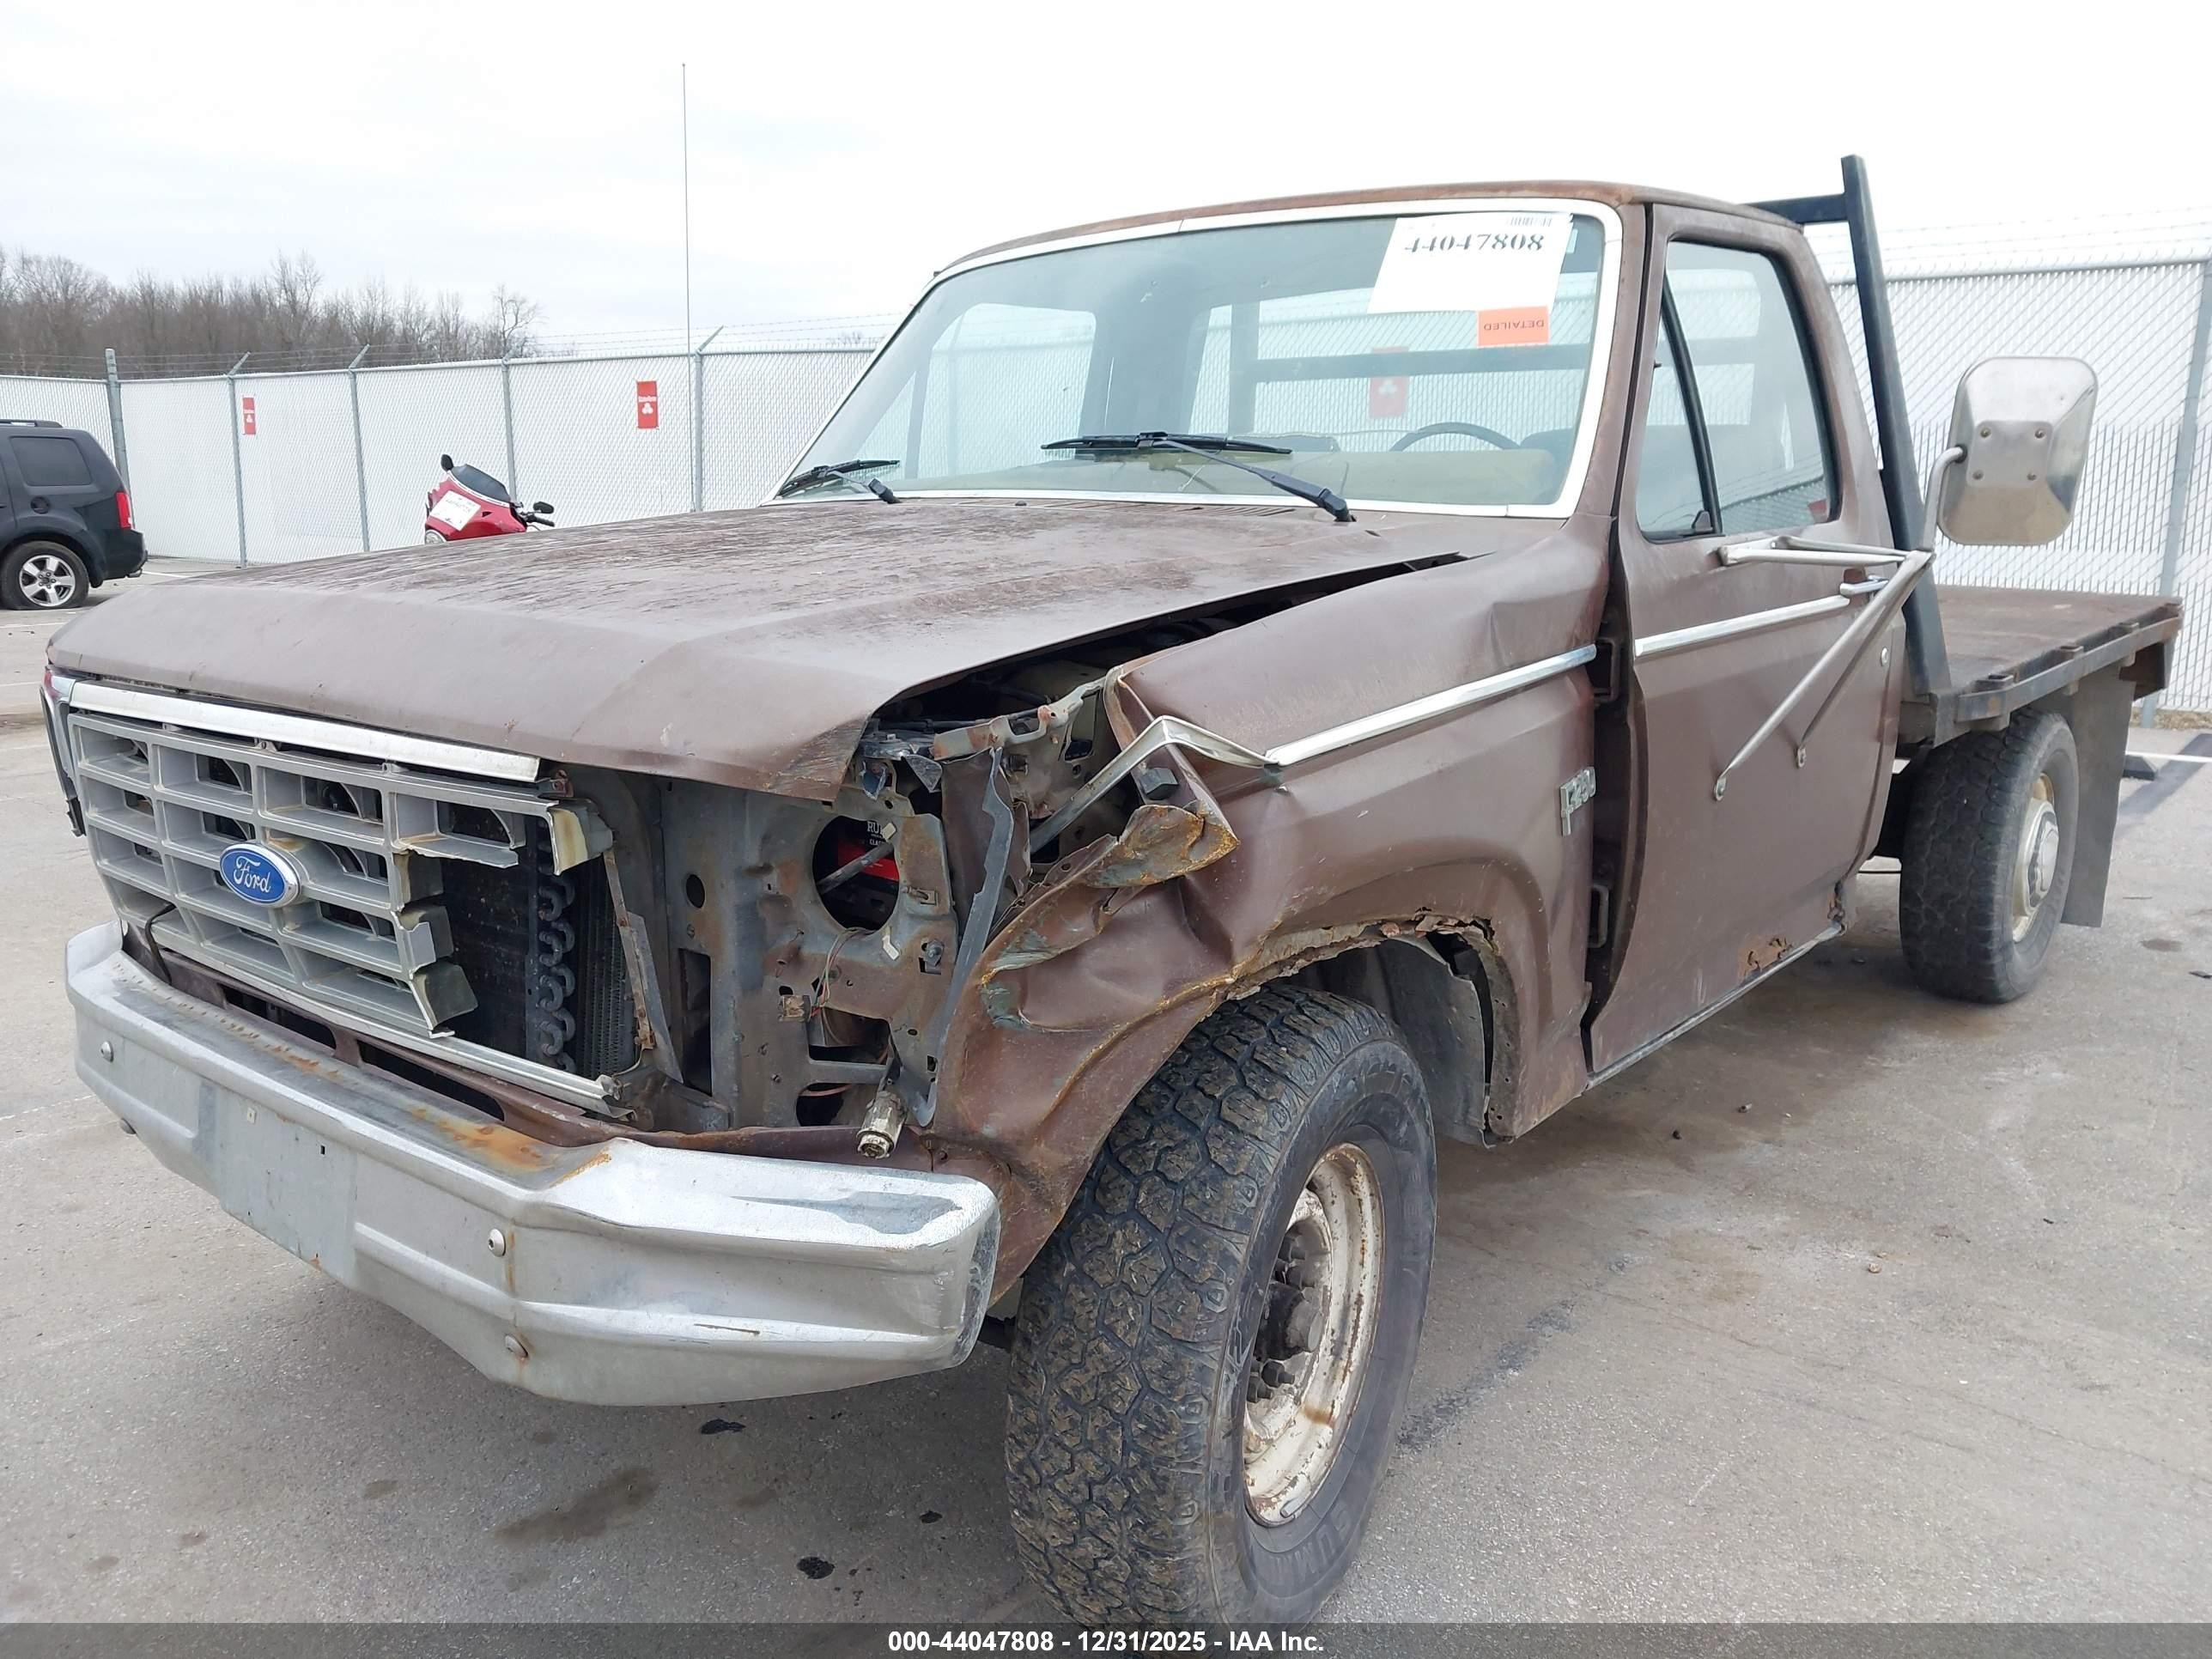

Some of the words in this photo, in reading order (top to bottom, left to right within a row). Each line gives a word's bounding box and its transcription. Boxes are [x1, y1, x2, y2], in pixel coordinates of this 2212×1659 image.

[1405, 233, 1545, 253] 44047808
[1483, 319, 1545, 331] DETAILED
[233, 855, 271, 894] Ford
